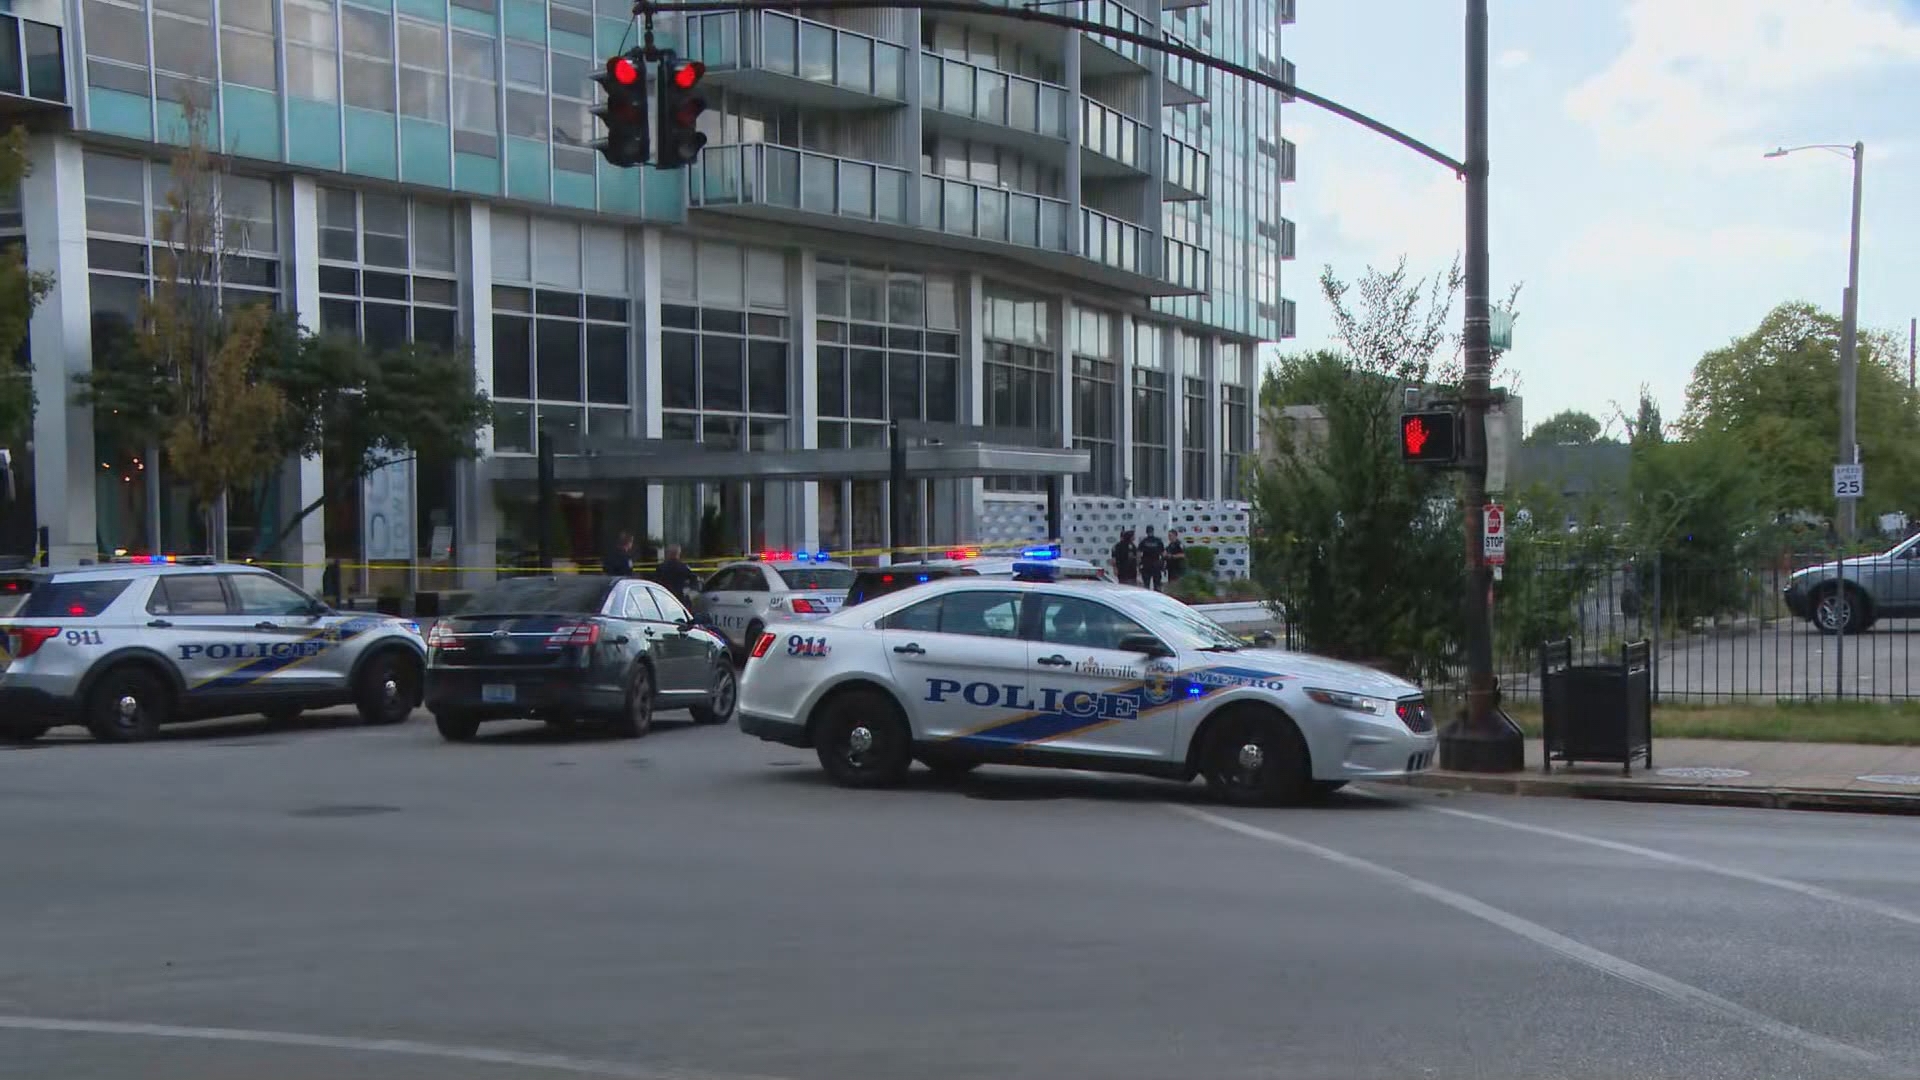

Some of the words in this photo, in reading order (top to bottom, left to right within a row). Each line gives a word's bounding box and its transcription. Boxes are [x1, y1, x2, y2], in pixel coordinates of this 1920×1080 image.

[1837, 481, 1860, 494] 25
[1485, 536, 1504, 548] STOP
[710, 614, 745, 629] LICE
[65, 630, 104, 647] 911
[787, 635, 827, 657] 911
[178, 641, 321, 660] POLICE
[1074, 661, 1138, 679] Louisville
[1193, 670, 1284, 691] METRO
[924, 678, 1140, 720] POLICE
